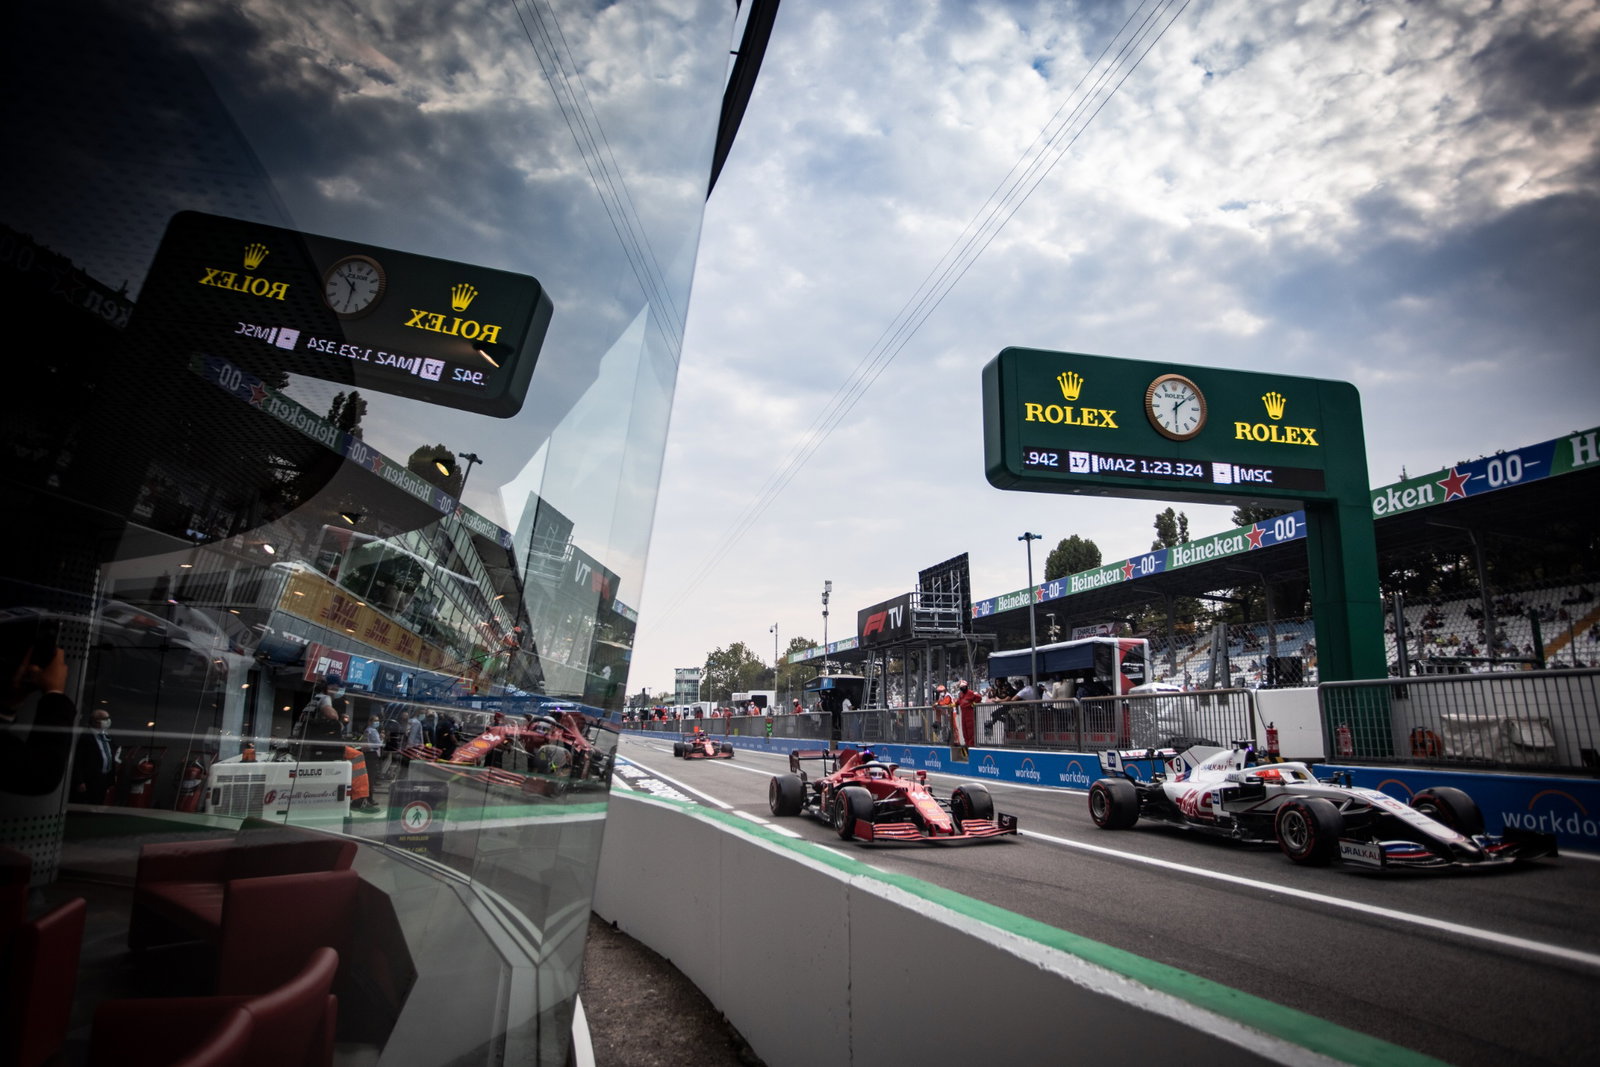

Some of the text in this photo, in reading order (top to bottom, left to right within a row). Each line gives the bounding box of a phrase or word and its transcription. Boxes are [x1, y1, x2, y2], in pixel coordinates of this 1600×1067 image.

[1164, 392, 1186, 401] ROLEX
[1025, 402, 1119, 429] ROLEX
[1234, 422, 1319, 447] ROLEX
[1071, 456, 1087, 469] 17
[1100, 457, 1136, 473] MAZ
[1140, 460, 1204, 478] 1:23.324
[1241, 469, 1273, 483] MSC
[1171, 535, 1244, 568] Heineken
[1071, 567, 1121, 593] Heineken
[998, 591, 1034, 612] Heineke
[888, 605, 904, 630] TV
[900, 756, 915, 766] workday
[925, 759, 942, 770] workday
[978, 763, 1000, 776] workday
[1175, 757, 1182, 772] 9
[1015, 768, 1041, 782] workday
[1059, 772, 1091, 786] workday
[1502, 810, 1600, 838] workda
